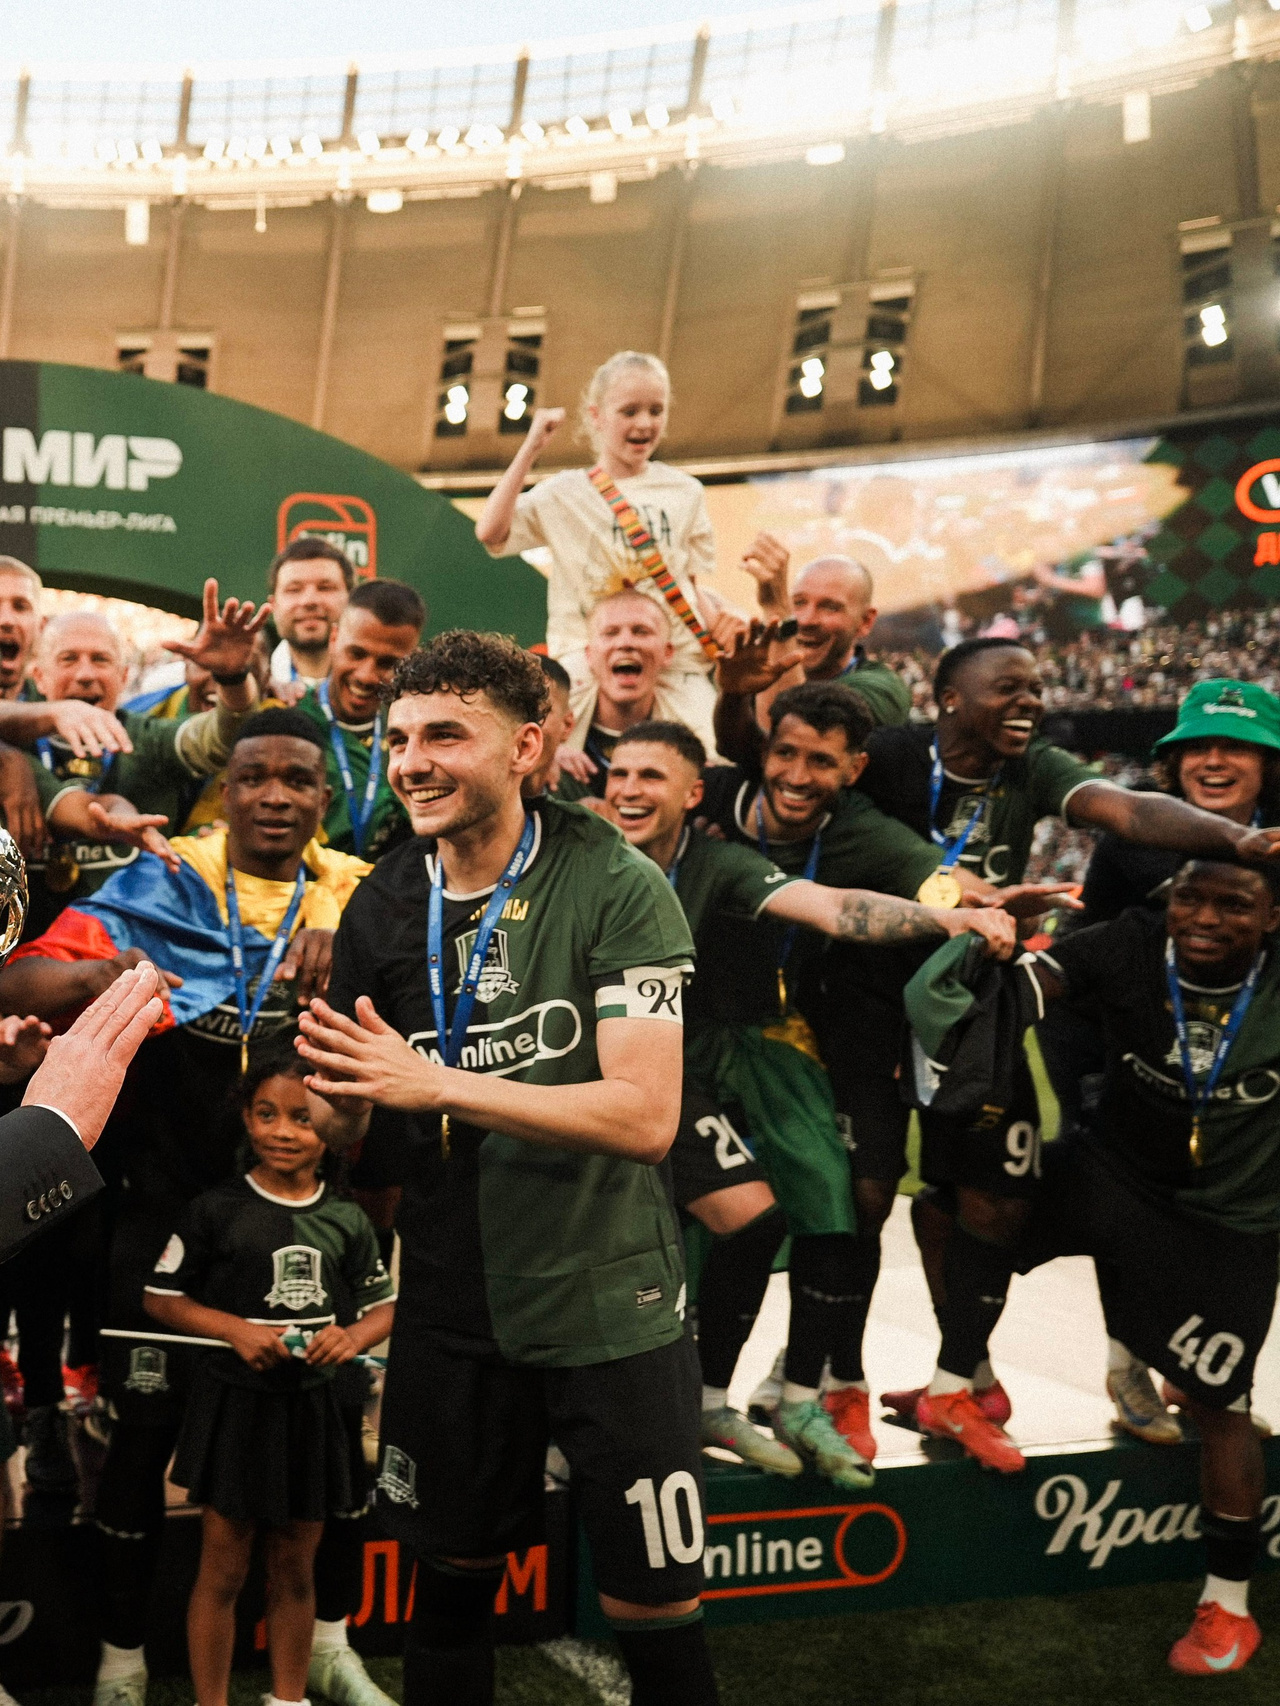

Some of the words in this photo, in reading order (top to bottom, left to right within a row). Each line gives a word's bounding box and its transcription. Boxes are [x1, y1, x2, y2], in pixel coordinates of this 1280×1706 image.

[3, 427, 182, 491] МИР
[29, 506, 177, 533] ПРЕМЬЕР-ЛИГА
[507, 850, 524, 877] МИР
[429, 968, 440, 996] МИР
[468, 953, 481, 981] МИР
[417, 1032, 536, 1069] Wnline
[1167, 1314, 1245, 1387] 40
[625, 1470, 704, 1568] 10
